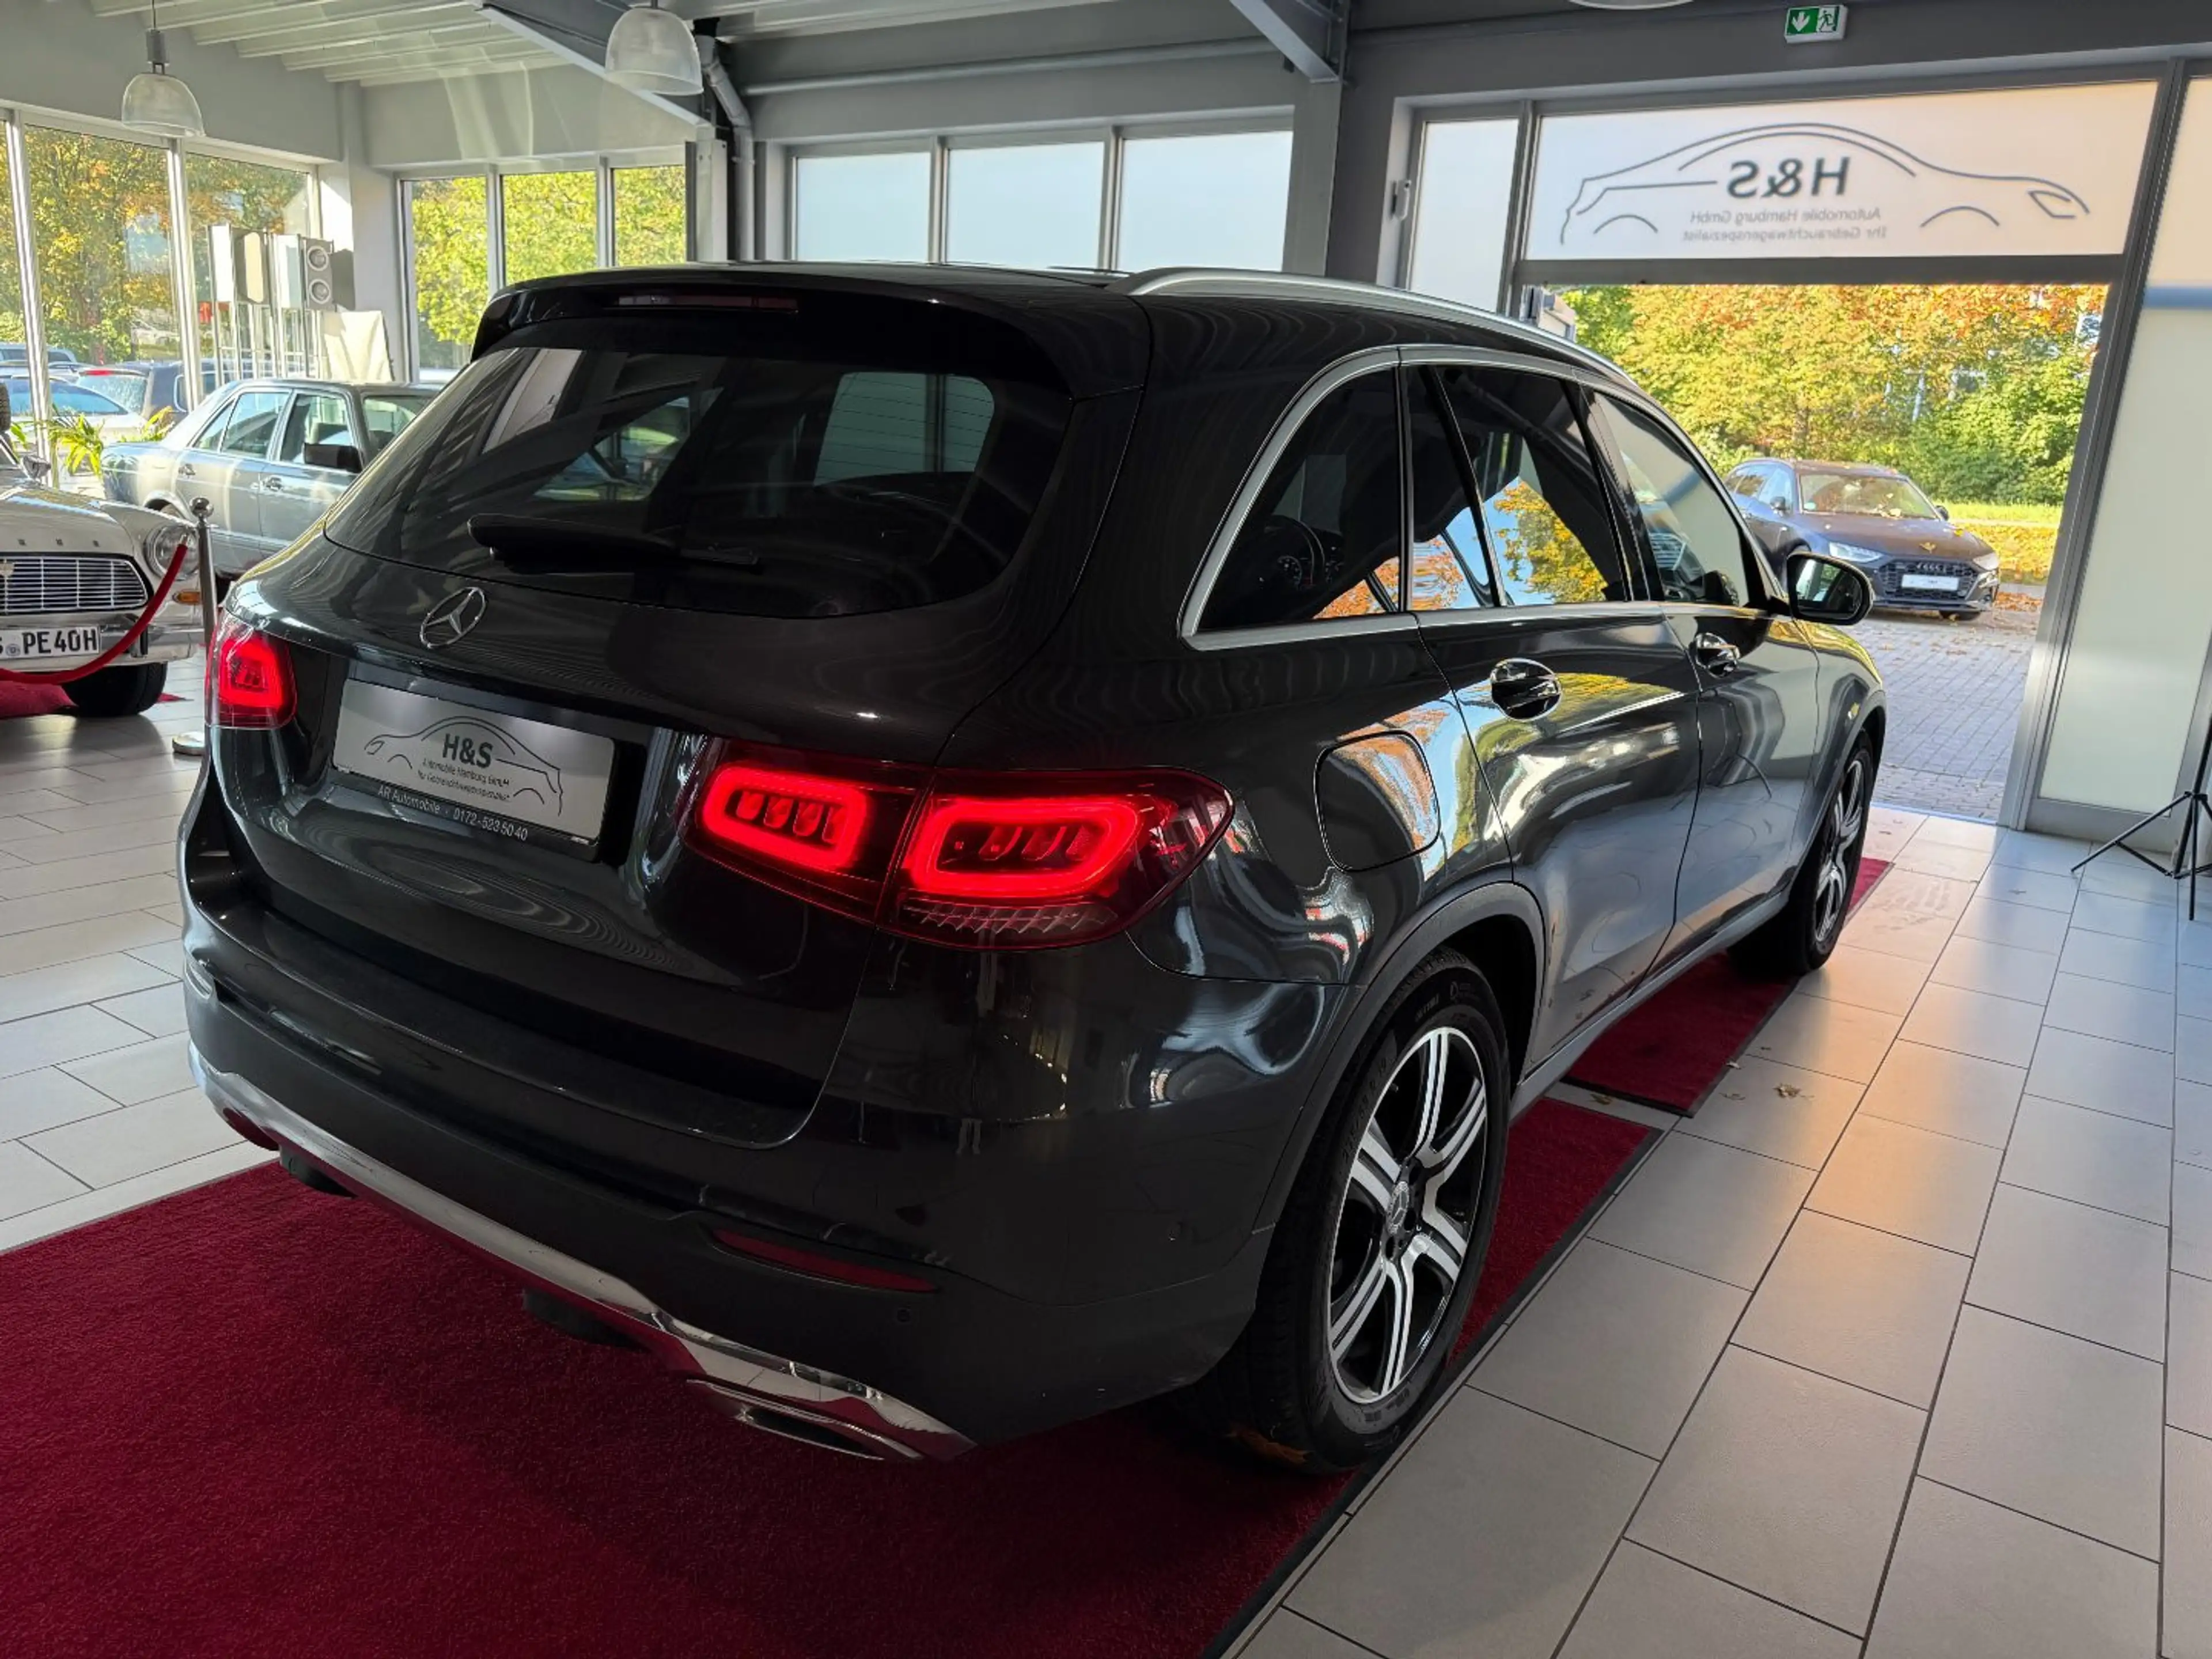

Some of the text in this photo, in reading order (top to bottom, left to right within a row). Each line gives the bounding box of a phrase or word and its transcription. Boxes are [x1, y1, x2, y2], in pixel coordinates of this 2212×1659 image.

[442, 733, 494, 768] H&S
[378, 785, 391, 800] AR
[392, 790, 440, 814] Automobile
